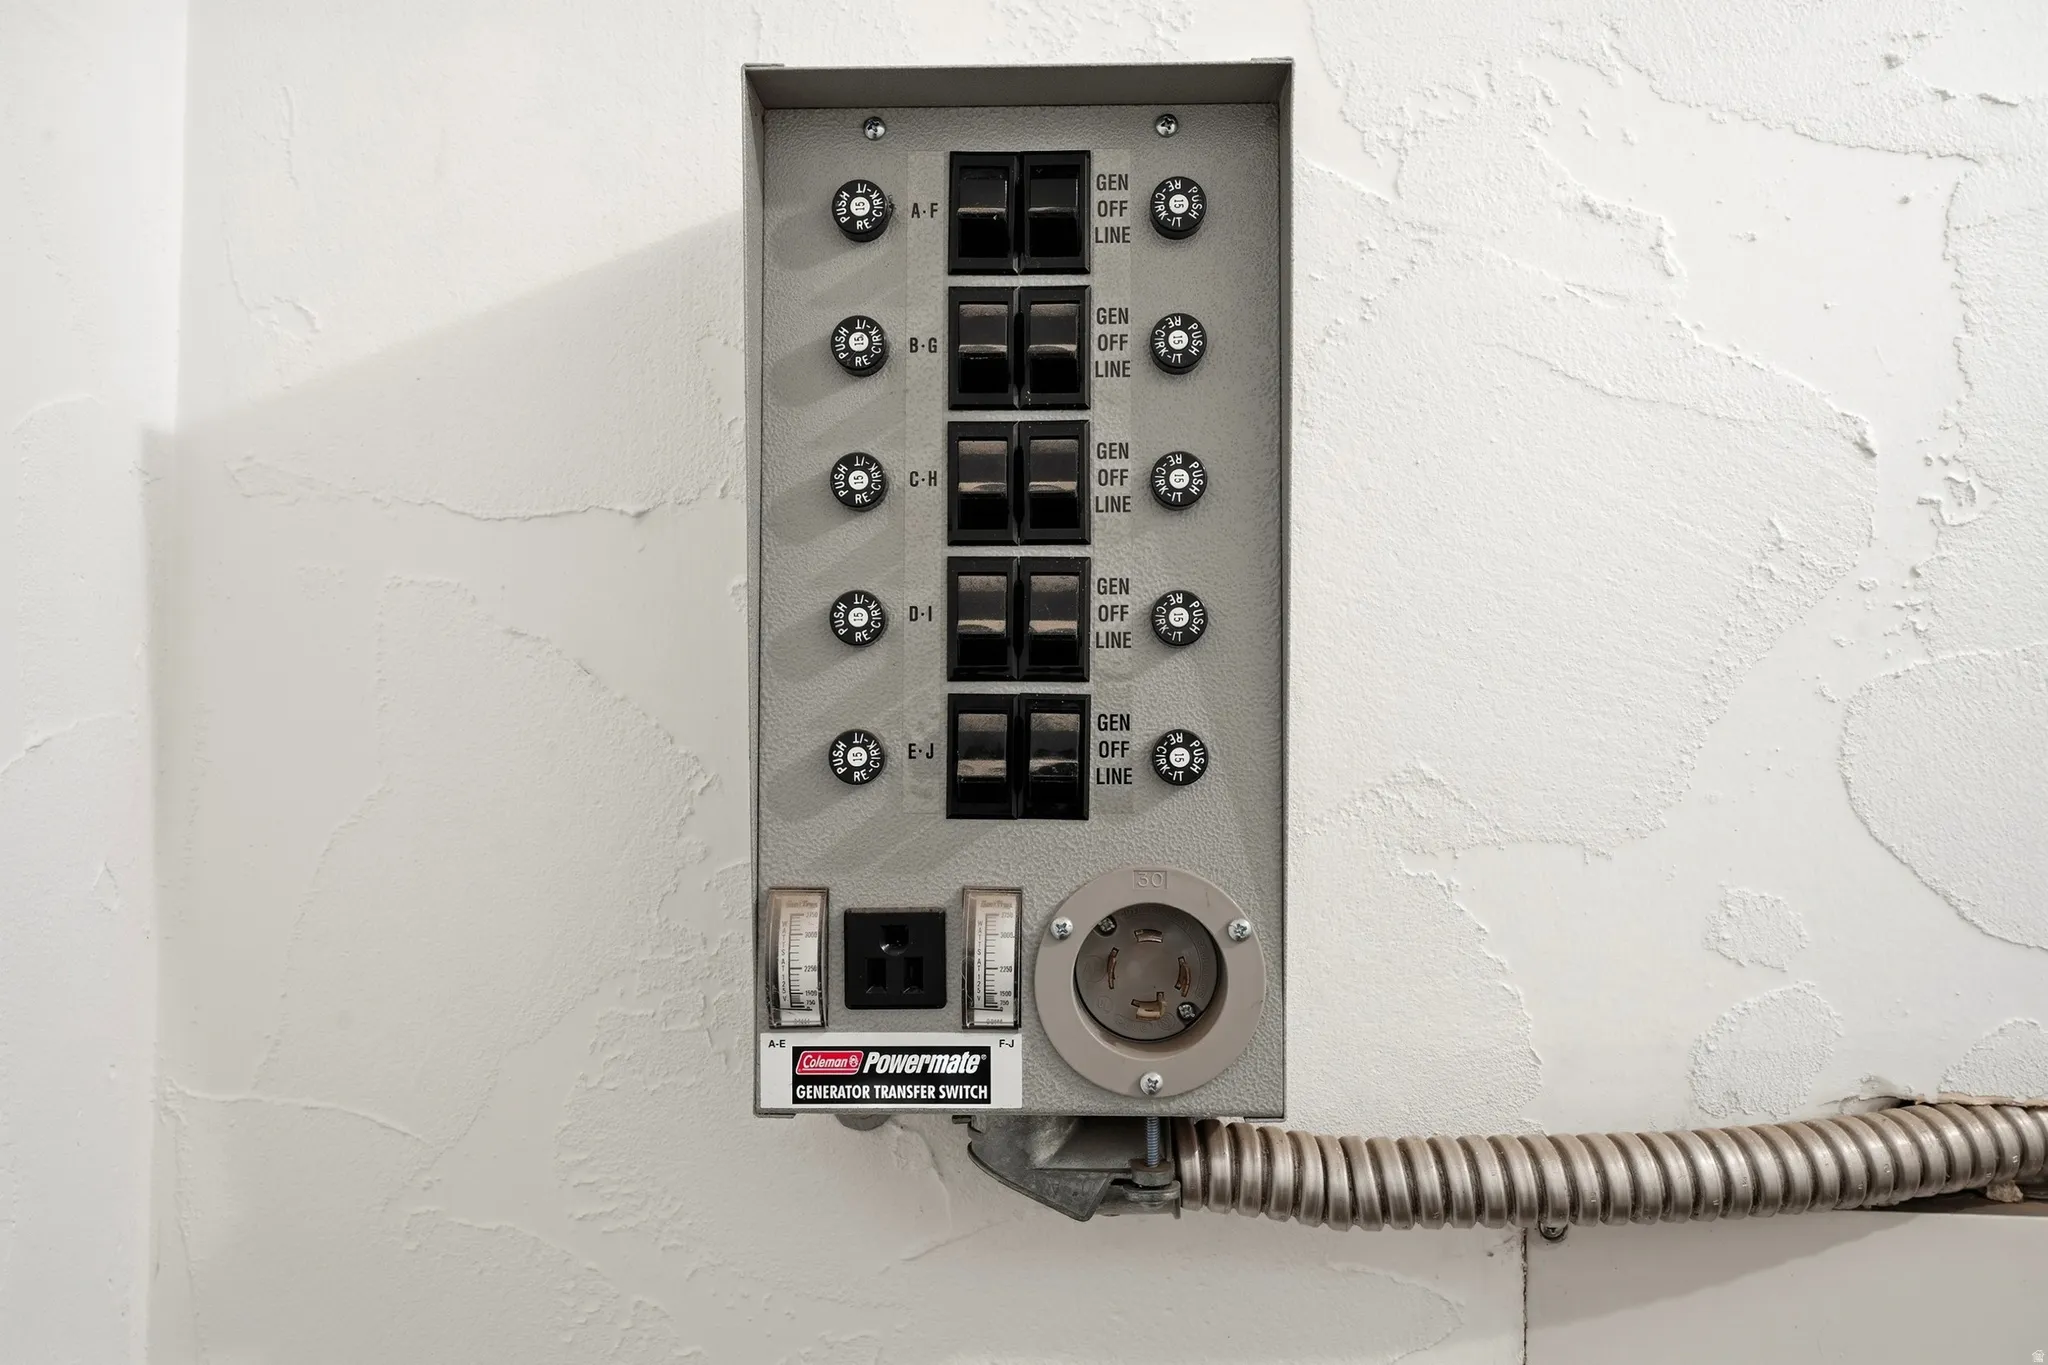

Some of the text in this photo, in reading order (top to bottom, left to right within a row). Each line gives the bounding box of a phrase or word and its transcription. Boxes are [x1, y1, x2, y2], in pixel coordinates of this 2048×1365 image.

[1096, 173, 1129, 191] GEN
[836, 191, 850, 224] PUSH
[855, 200, 865, 211] 15
[1097, 200, 1129, 218] OFF
[1173, 199, 1184, 209] 15
[1187, 185, 1202, 220] PUSH
[1094, 226, 1131, 244] LINE
[1096, 307, 1129, 325] GEN
[835, 326, 849, 360] PUSH
[853, 335, 864, 346] 15
[1097, 333, 1129, 352] OFF
[1173, 335, 1184, 345] 15
[1188, 322, 1203, 357] PUSH
[1095, 360, 1131, 378] LINE
[1096, 442, 1129, 460] GEN
[834, 464, 848, 497] PUSH
[853, 474, 864, 485] 15
[1097, 468, 1129, 487] OFF
[1173, 474, 1185, 485] 15
[1188, 460, 1204, 496] PUSH
[1095, 495, 1132, 513] LINE
[1097, 577, 1130, 596] GEN
[834, 602, 848, 635] PUSH
[853, 611, 864, 622] 15
[1098, 604, 1129, 622] OFF
[1173, 611, 1184, 622] 15
[1189, 600, 1204, 635] PUSH
[1095, 631, 1132, 649] LINE
[1097, 713, 1131, 732] GEN
[832, 740, 847, 775] PUSH
[852, 751, 863, 762] 15
[1098, 740, 1130, 759] OFF
[1173, 752, 1185, 762] 15
[1189, 739, 1203, 775] PUSH
[1096, 767, 1133, 785] LINE
[1137, 871, 1164, 888] 30
[999, 965, 1013, 973] 2250
[768, 1039, 786, 1048] A-E
[999, 1039, 1015, 1048] F-J
[802, 1054, 847, 1069] Coleman
[796, 1084, 988, 1100] GENERATOR TRANSFER SWITCH
